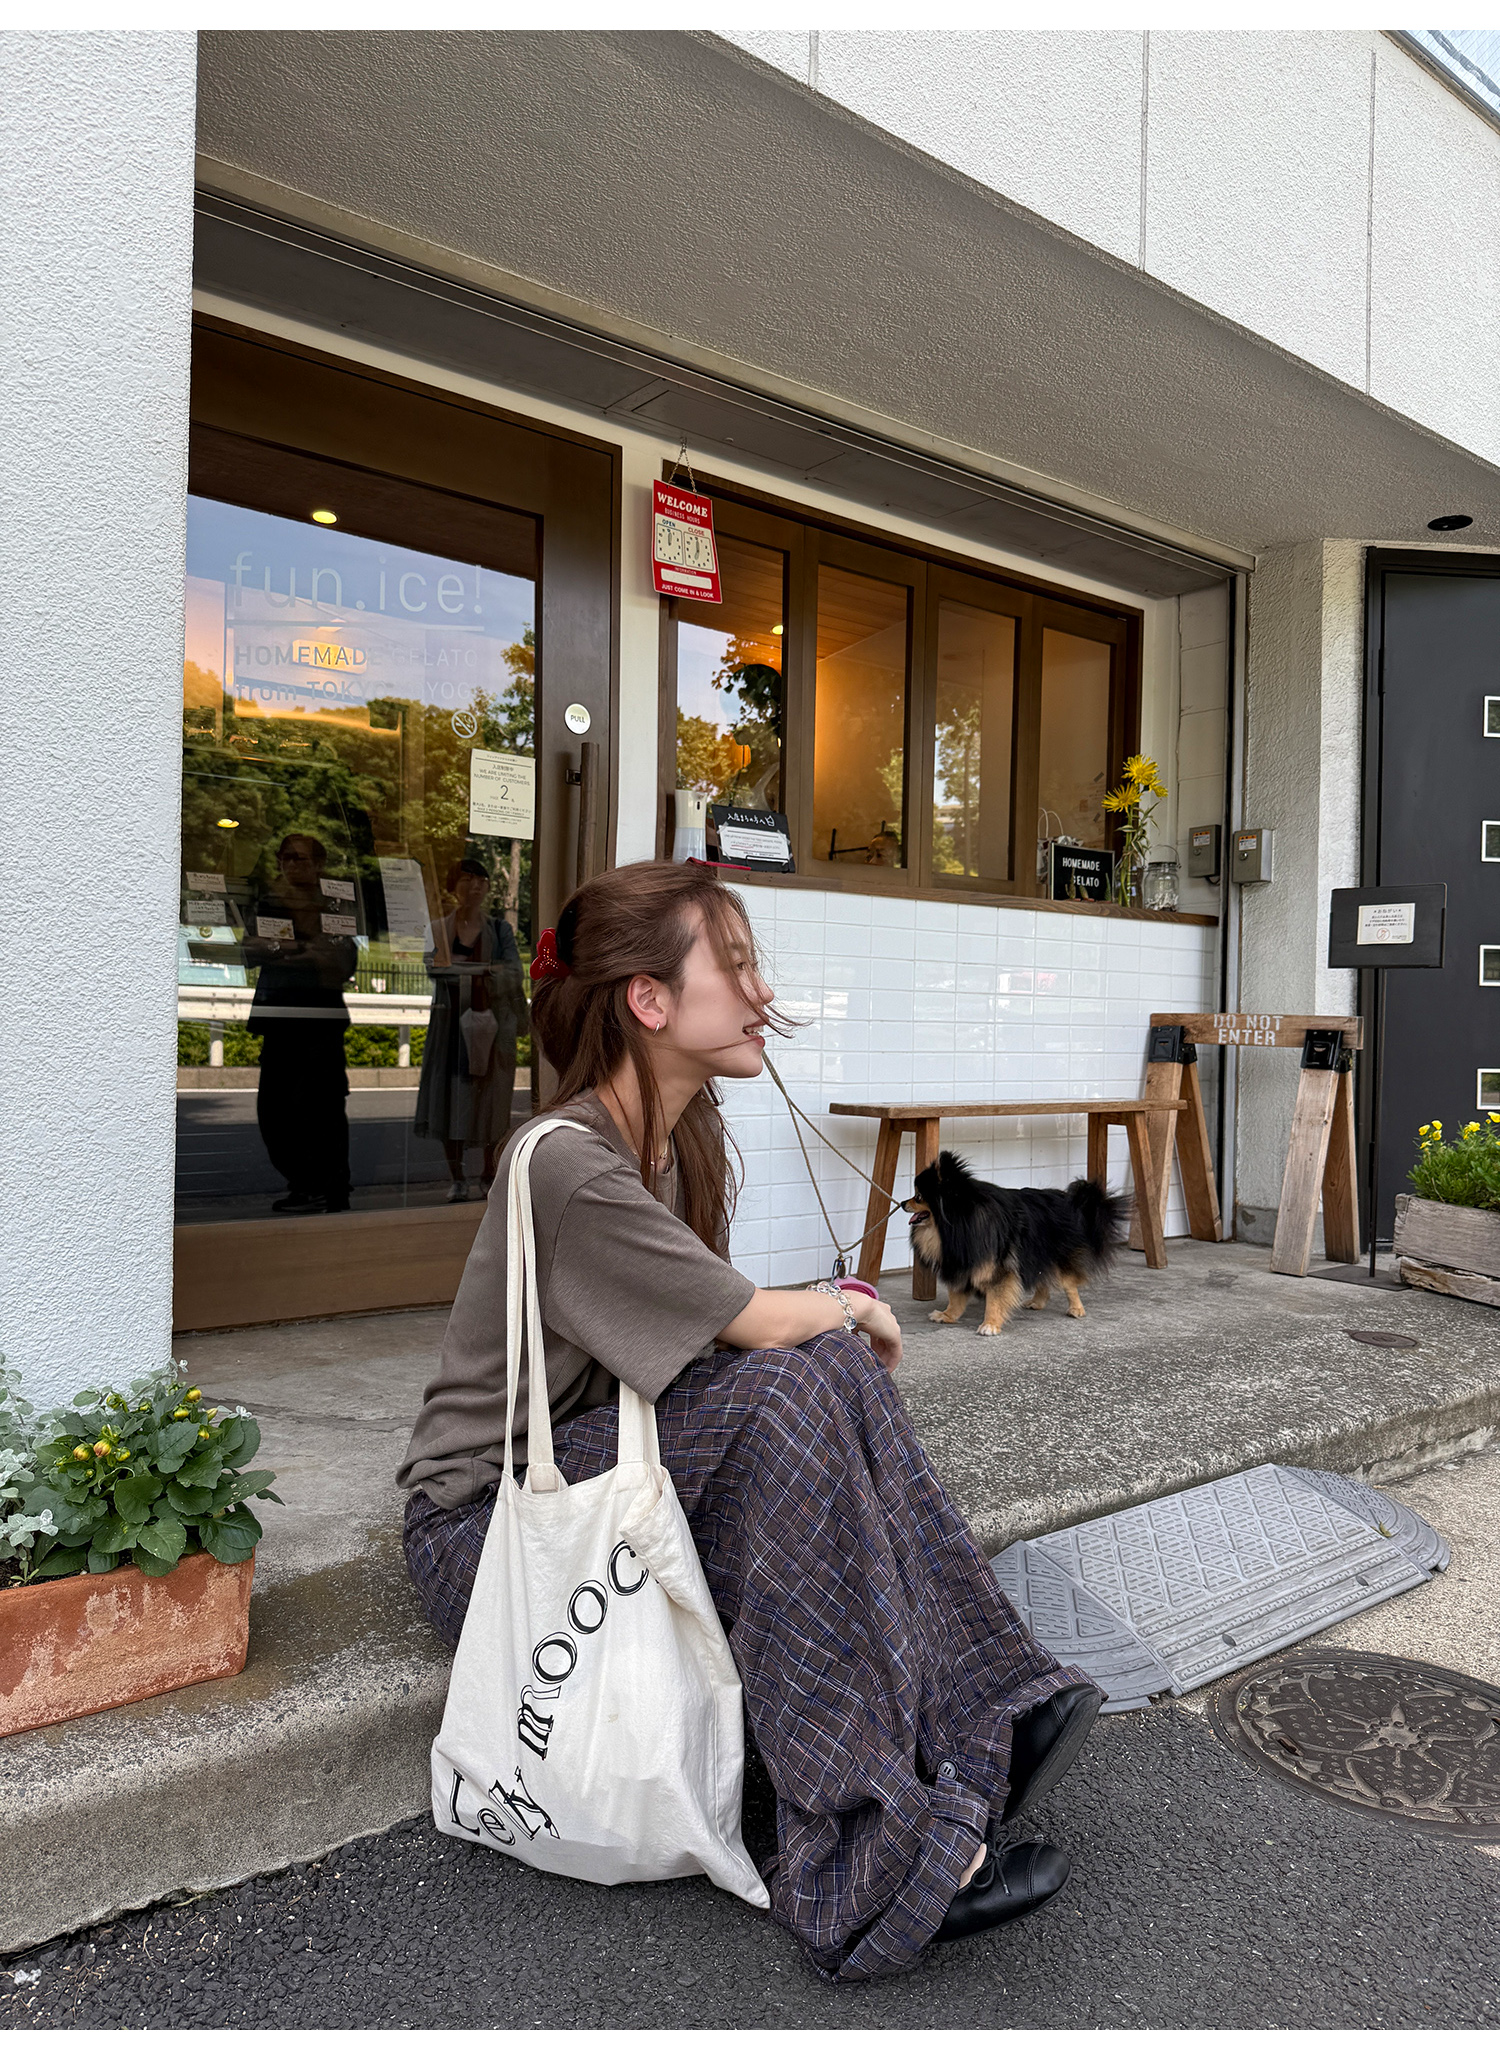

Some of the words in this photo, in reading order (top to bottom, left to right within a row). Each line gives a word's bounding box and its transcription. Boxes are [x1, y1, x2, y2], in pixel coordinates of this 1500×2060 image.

[657, 491, 708, 518] WELCOME
[662, 519, 675, 527] OPEN
[665, 508, 684, 520] BUSINESS
[687, 515, 700, 524] HOURS
[688, 527, 704, 536] CLOSE
[229, 551, 483, 614] fun.ice!
[674, 586, 689, 595] COME
[235, 645, 382, 667] HOMEMADE
[391, 647, 478, 667] GELATO
[235, 682, 297, 702] from
[571, 714, 585, 723] PULL
[502, 778, 530, 786] CUSTOMERS
[500, 785, 509, 800] 2
[1062, 857, 1100, 871] HOMEMADE
[1213, 1013, 1237, 1029] DO
[1246, 1014, 1284, 1031] NOT
[1218, 1029, 1276, 1046] ENTER
